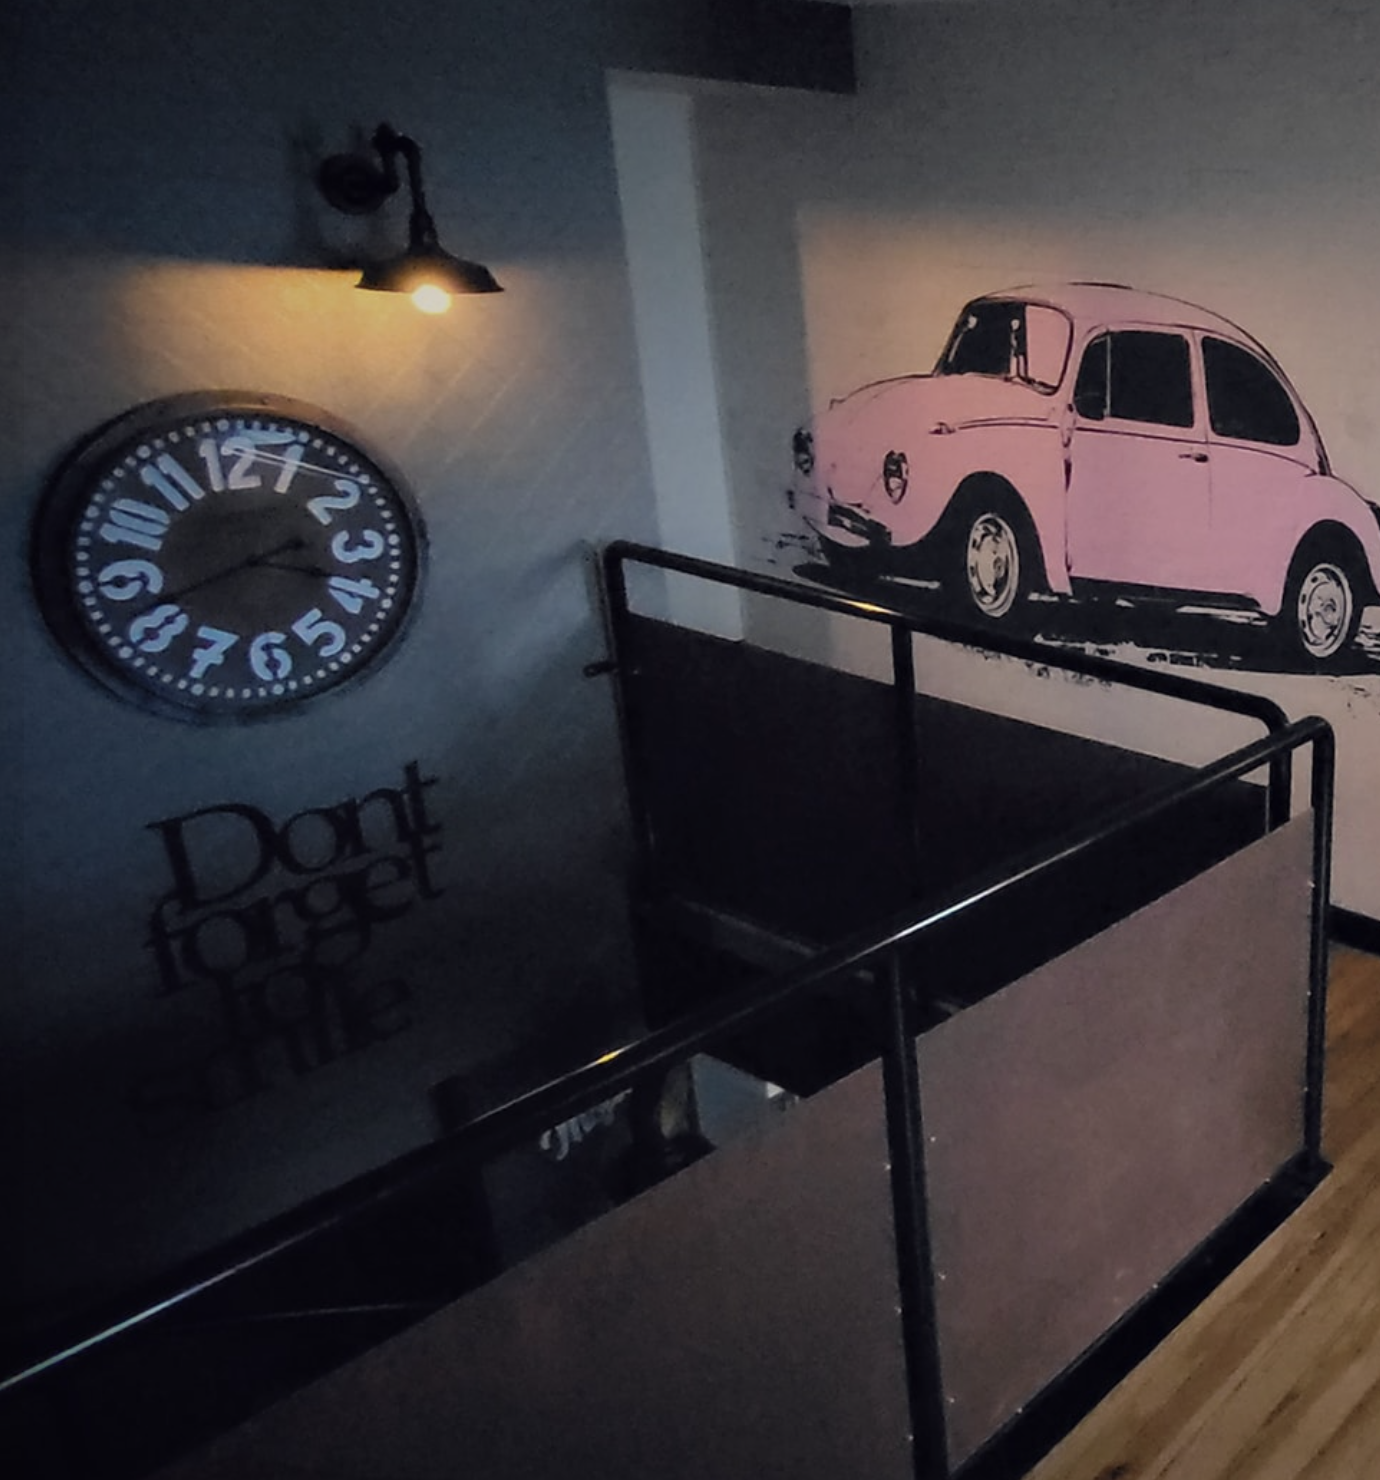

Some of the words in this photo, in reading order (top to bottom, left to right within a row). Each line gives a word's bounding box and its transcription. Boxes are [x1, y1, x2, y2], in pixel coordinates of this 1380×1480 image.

[140, 453, 206, 512] 11
[199, 436, 263, 492] 12
[265, 434, 306, 494] 1
[100, 498, 170, 552] 10
[306, 478, 361, 526] 2
[331, 529, 384, 563] 3
[97, 559, 164, 601] 9
[328, 575, 381, 615] 4
[129, 603, 190, 653] 8
[189, 625, 240, 679] 7
[291, 607, 347, 658] 5
[249, 631, 293, 681] 6
[144, 834, 446, 998] forget
